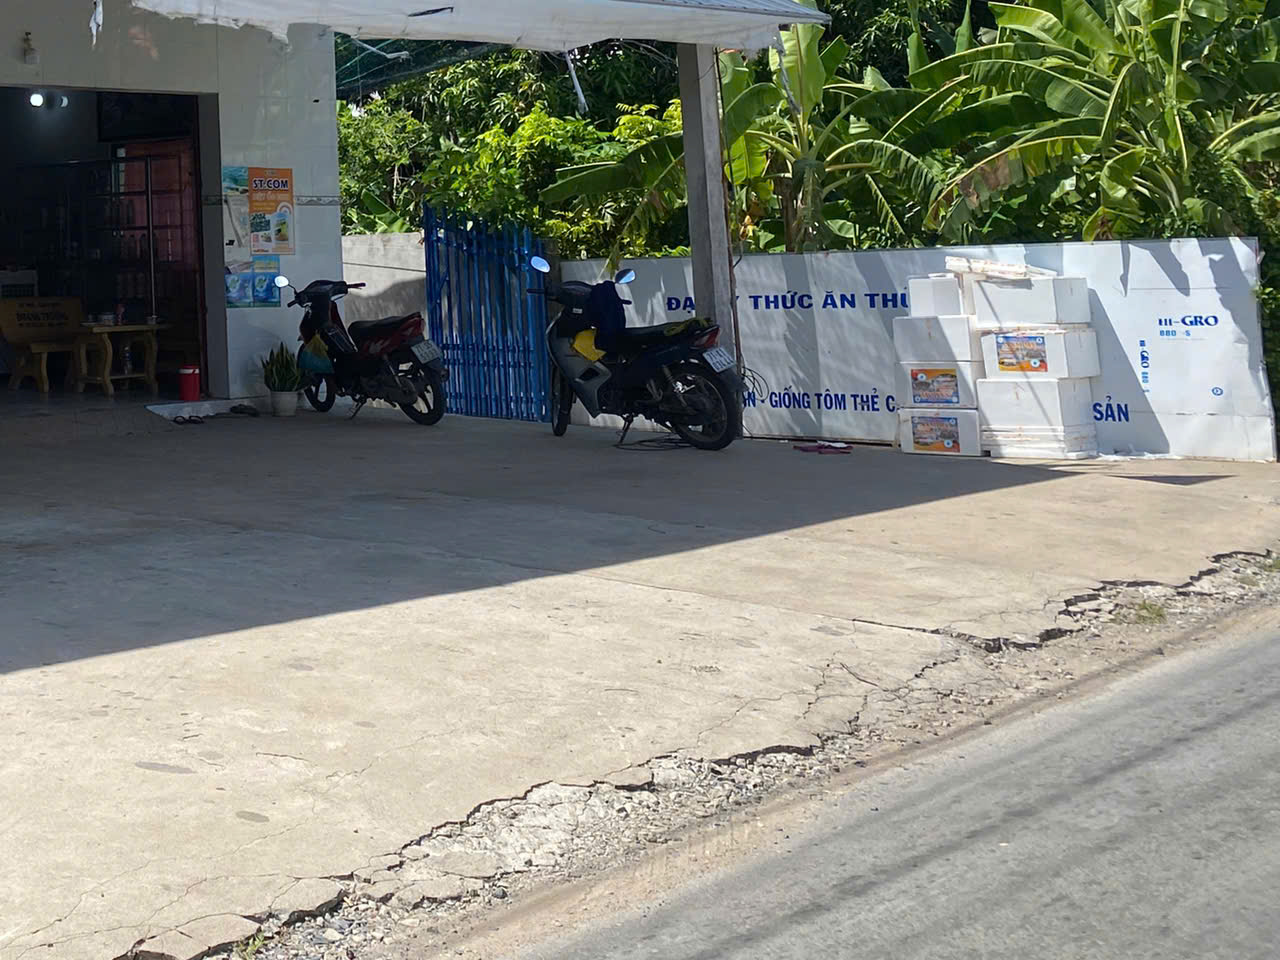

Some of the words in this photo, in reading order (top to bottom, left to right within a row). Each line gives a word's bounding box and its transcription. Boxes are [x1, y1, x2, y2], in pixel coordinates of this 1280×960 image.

[252, 178, 289, 190] ST.COM
[666, 295, 696, 313] ĐẠ
[748, 289, 814, 311] THỨC
[821, 291, 857, 310] ĂN
[769, 385, 811, 410] GIỐNG
[815, 389, 846, 411] TÔM
[850, 388, 879, 412] THẺ
[1092, 395, 1130, 422] SẢN
